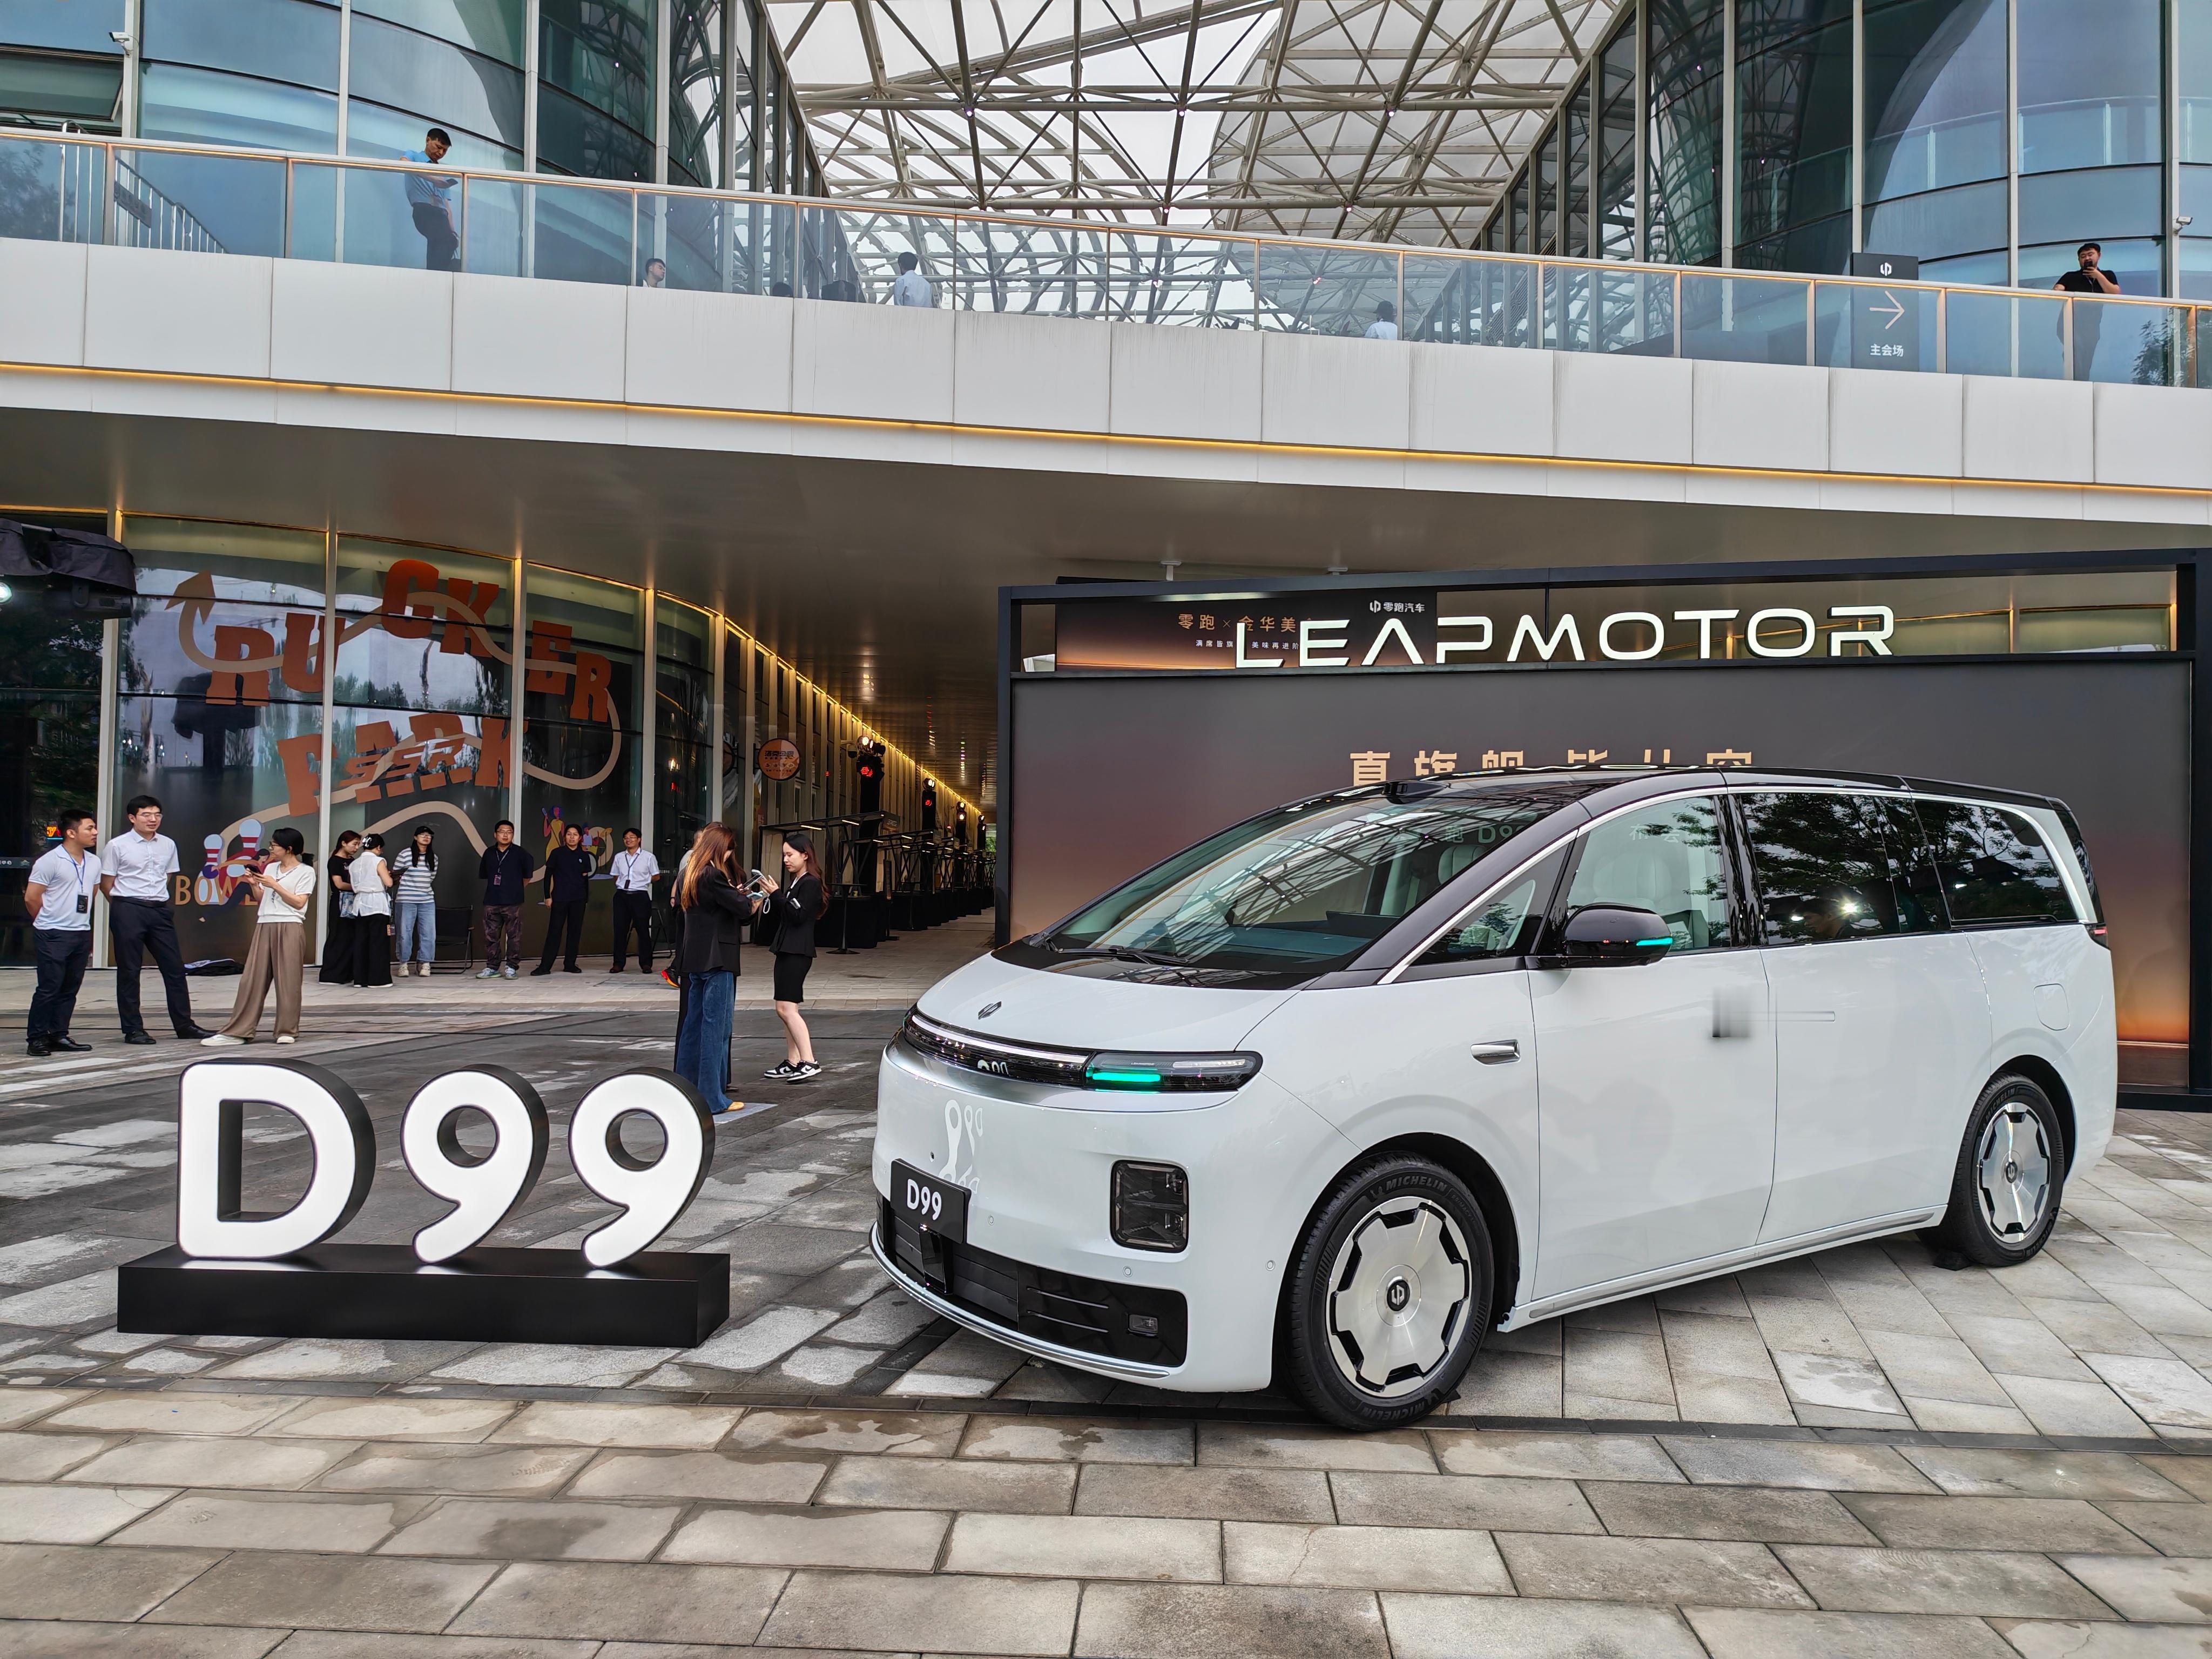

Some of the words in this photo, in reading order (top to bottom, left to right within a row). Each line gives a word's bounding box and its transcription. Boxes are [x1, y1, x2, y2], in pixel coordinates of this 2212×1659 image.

[1870, 343, 1904, 358] 主会场
[1383, 602, 1426, 613] 零跑汽车
[1235, 605, 1894, 668] LEAPMOTOR
[1251, 642, 1299, 650] 美味再进阶
[177, 1058, 713, 1269] D99
[1386, 1176, 1447, 1192] MICHELIN
[907, 1178, 942, 1220] D99
